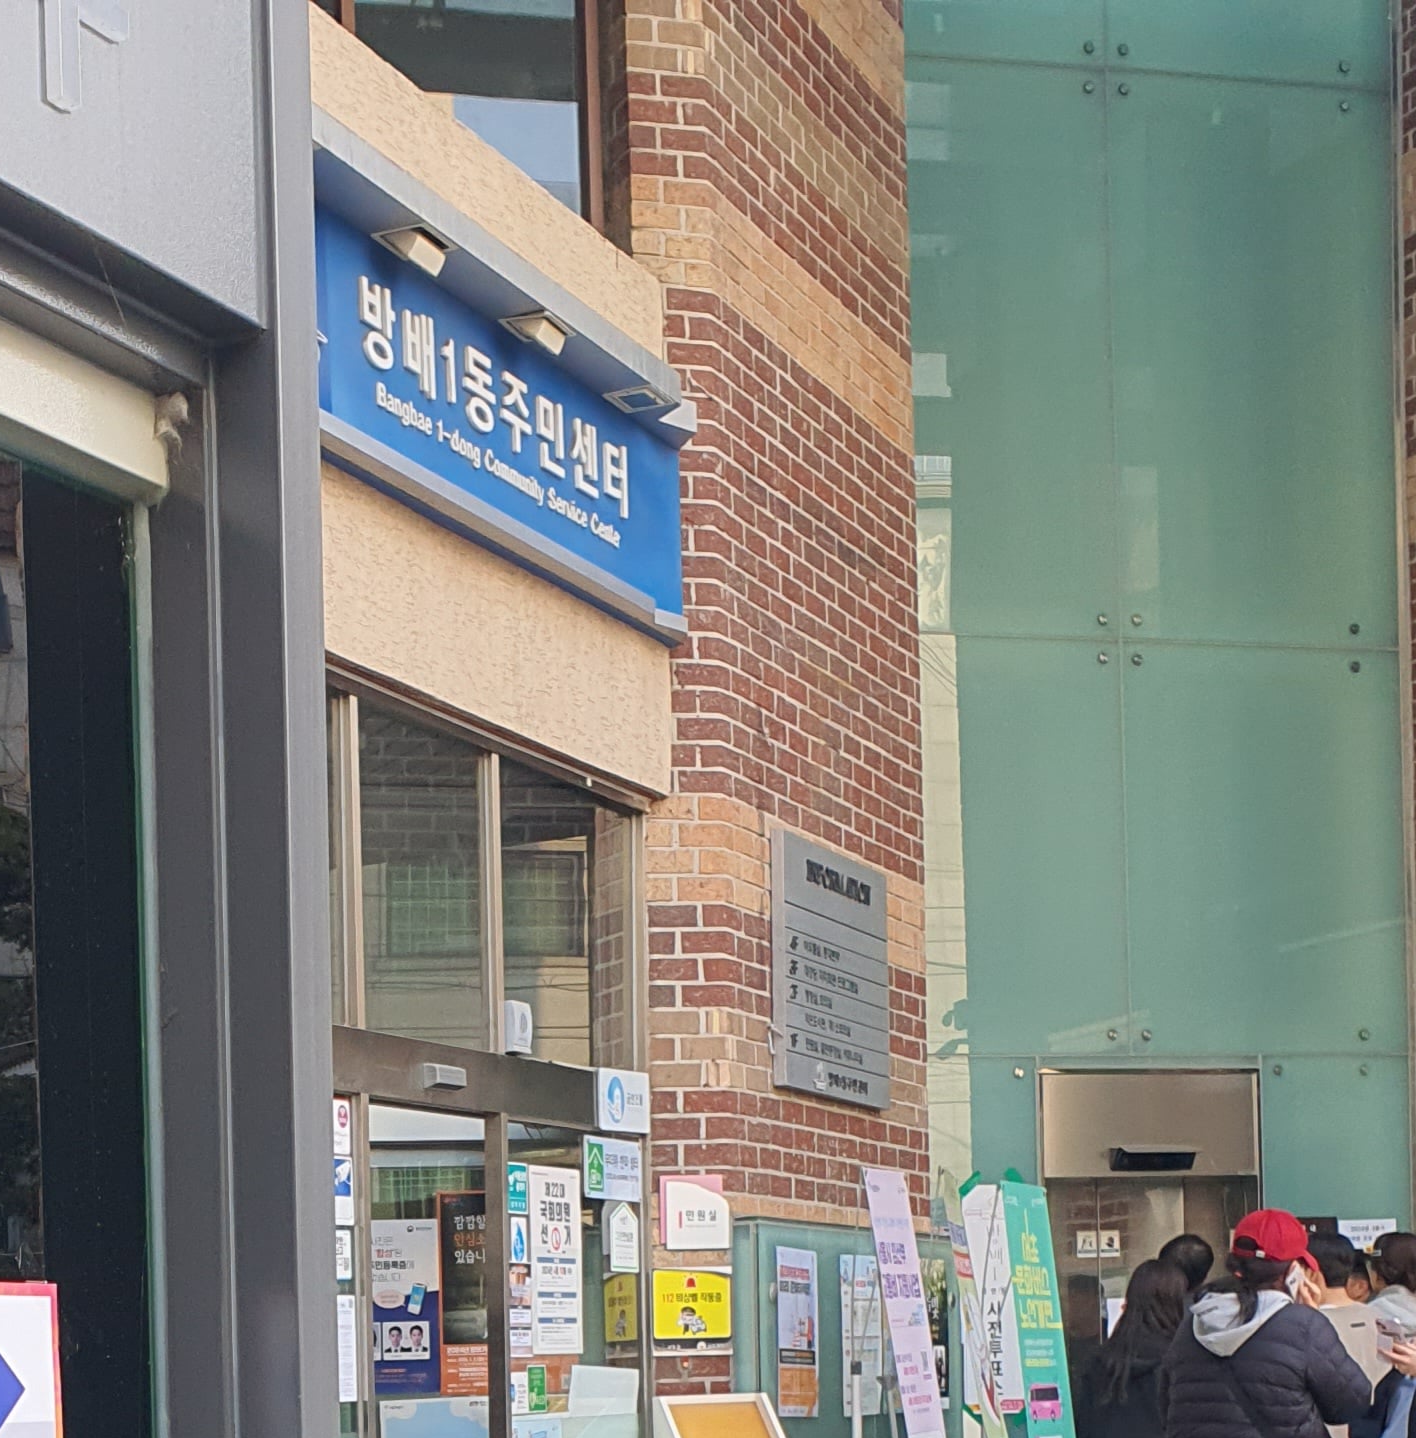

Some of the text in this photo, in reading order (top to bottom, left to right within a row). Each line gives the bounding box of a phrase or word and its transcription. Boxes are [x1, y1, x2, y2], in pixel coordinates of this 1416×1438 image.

[358, 275, 629, 519] 방배1동주민센터
[375, 381, 433, 436] Bangbae
[436, 419, 481, 469] 1-dong
[484, 448, 544, 507] Community
[547, 486, 588, 528] Service
[662, 1293, 675, 1304] 112
